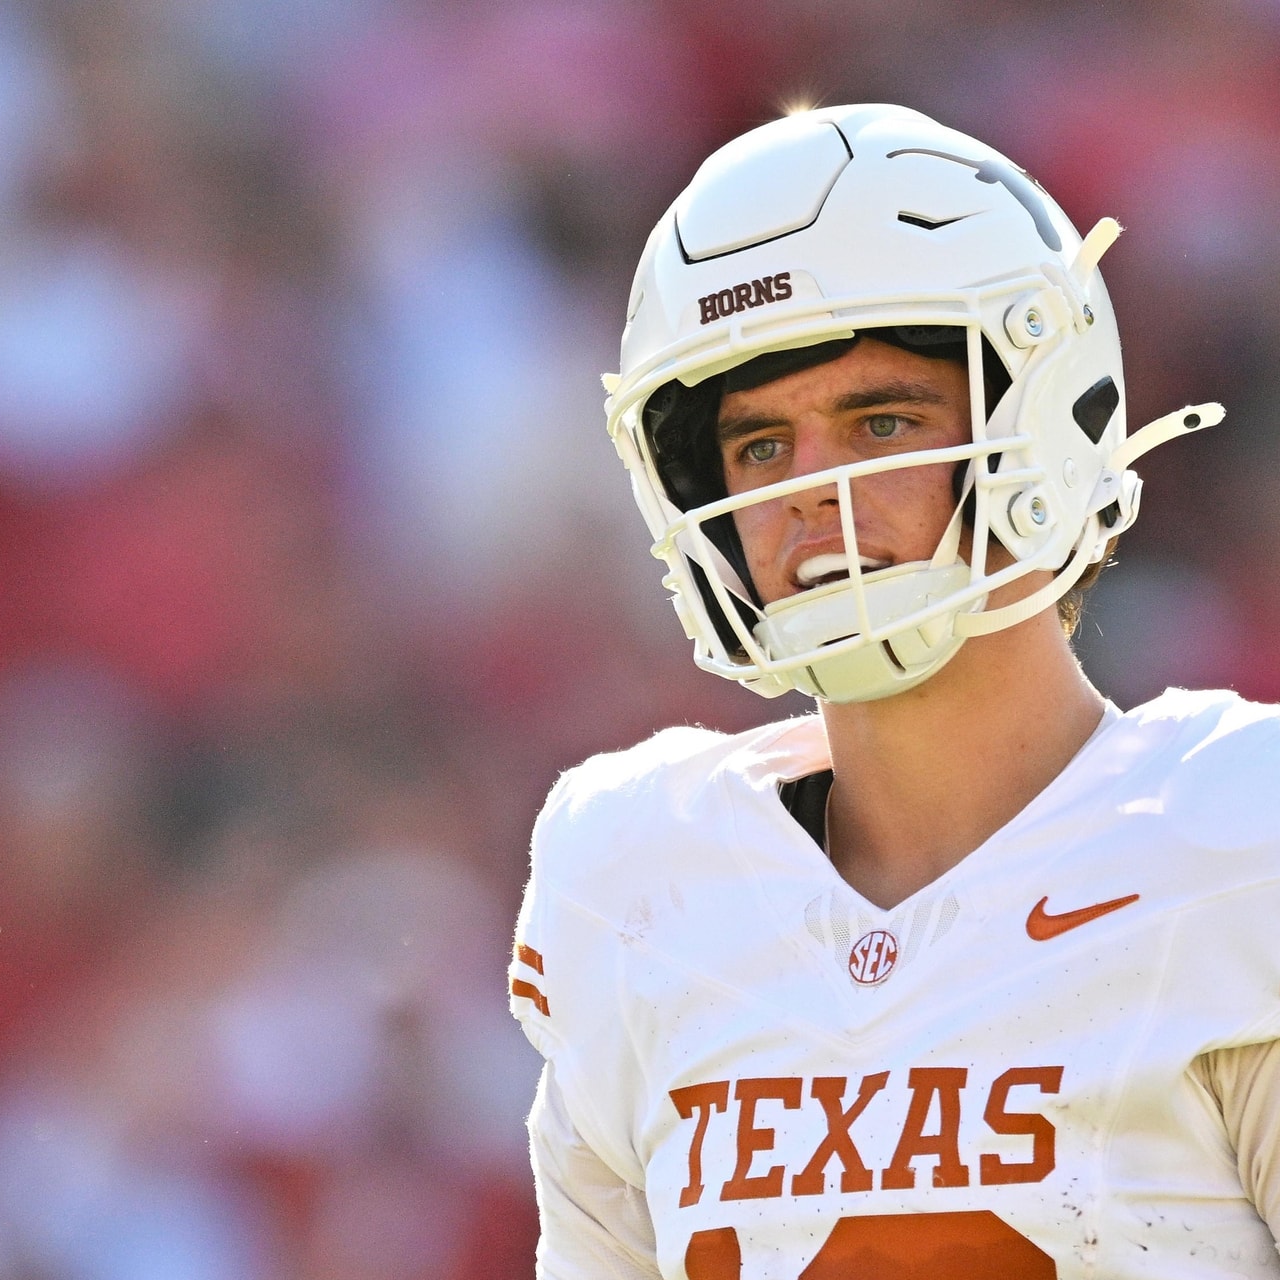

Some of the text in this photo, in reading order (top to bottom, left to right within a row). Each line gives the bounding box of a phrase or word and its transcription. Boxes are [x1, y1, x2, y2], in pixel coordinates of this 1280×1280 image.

[698, 272, 792, 325] HORNS
[849, 931, 897, 983] SEC
[669, 1066, 1064, 1208] TEXAS
